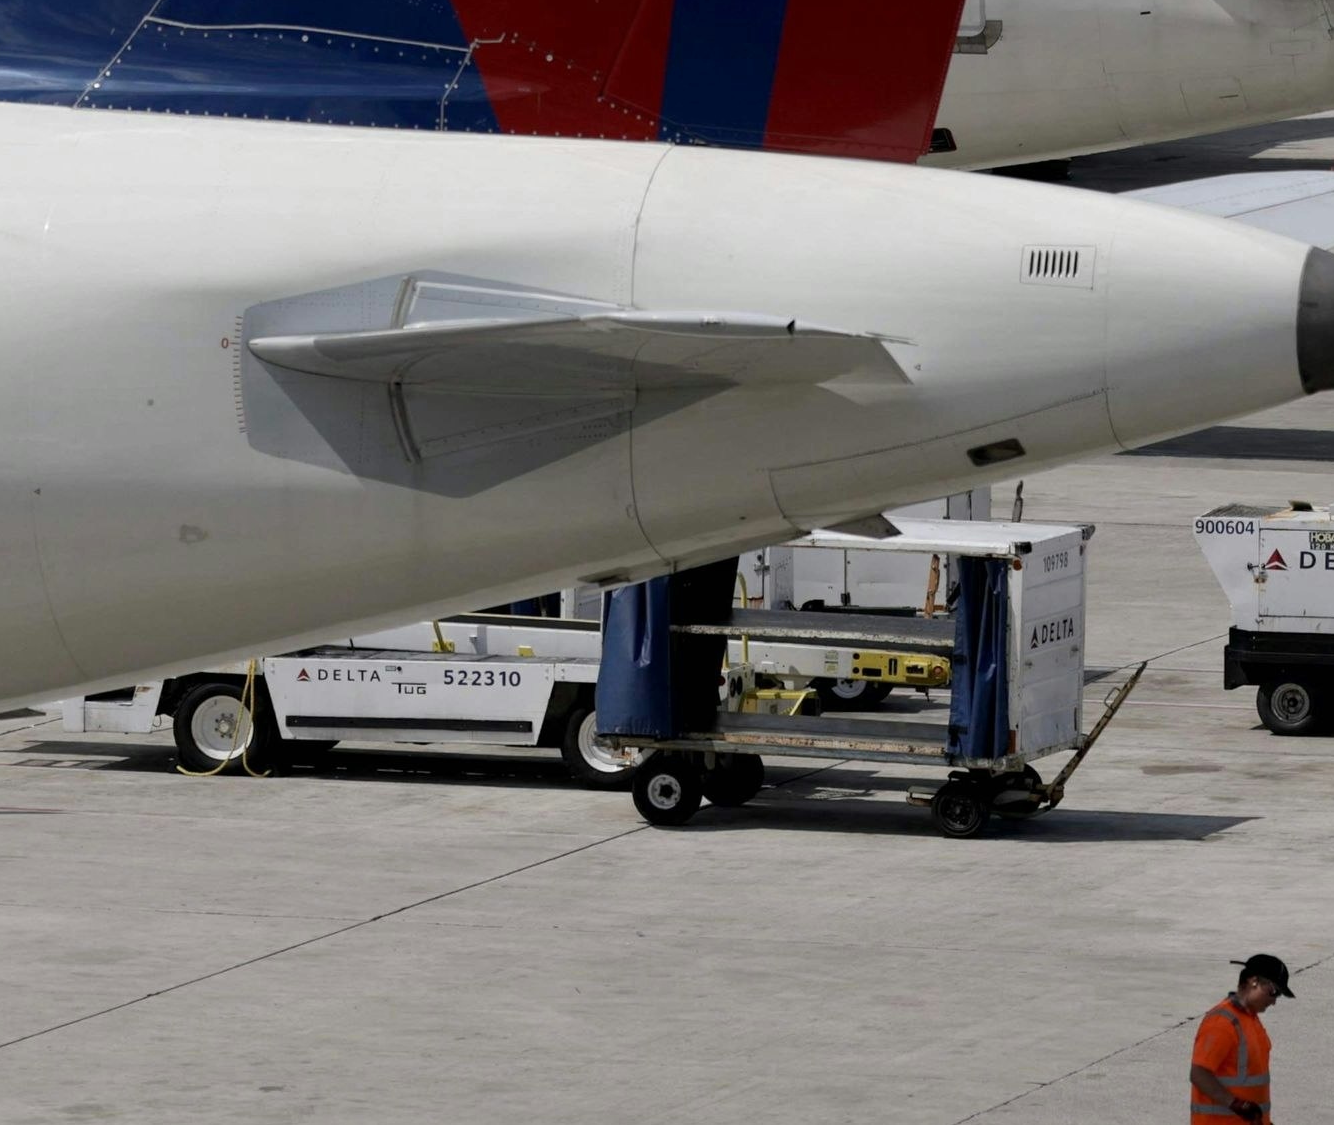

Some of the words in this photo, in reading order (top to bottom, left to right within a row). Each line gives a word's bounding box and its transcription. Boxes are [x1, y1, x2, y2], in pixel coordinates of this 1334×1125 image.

[1195, 520, 1255, 535] 900604
[1043, 552, 1068, 573] 109798
[1042, 618, 1073, 644] DELTA
[318, 669, 381, 682] DELTA
[443, 670, 521, 686] 522310
